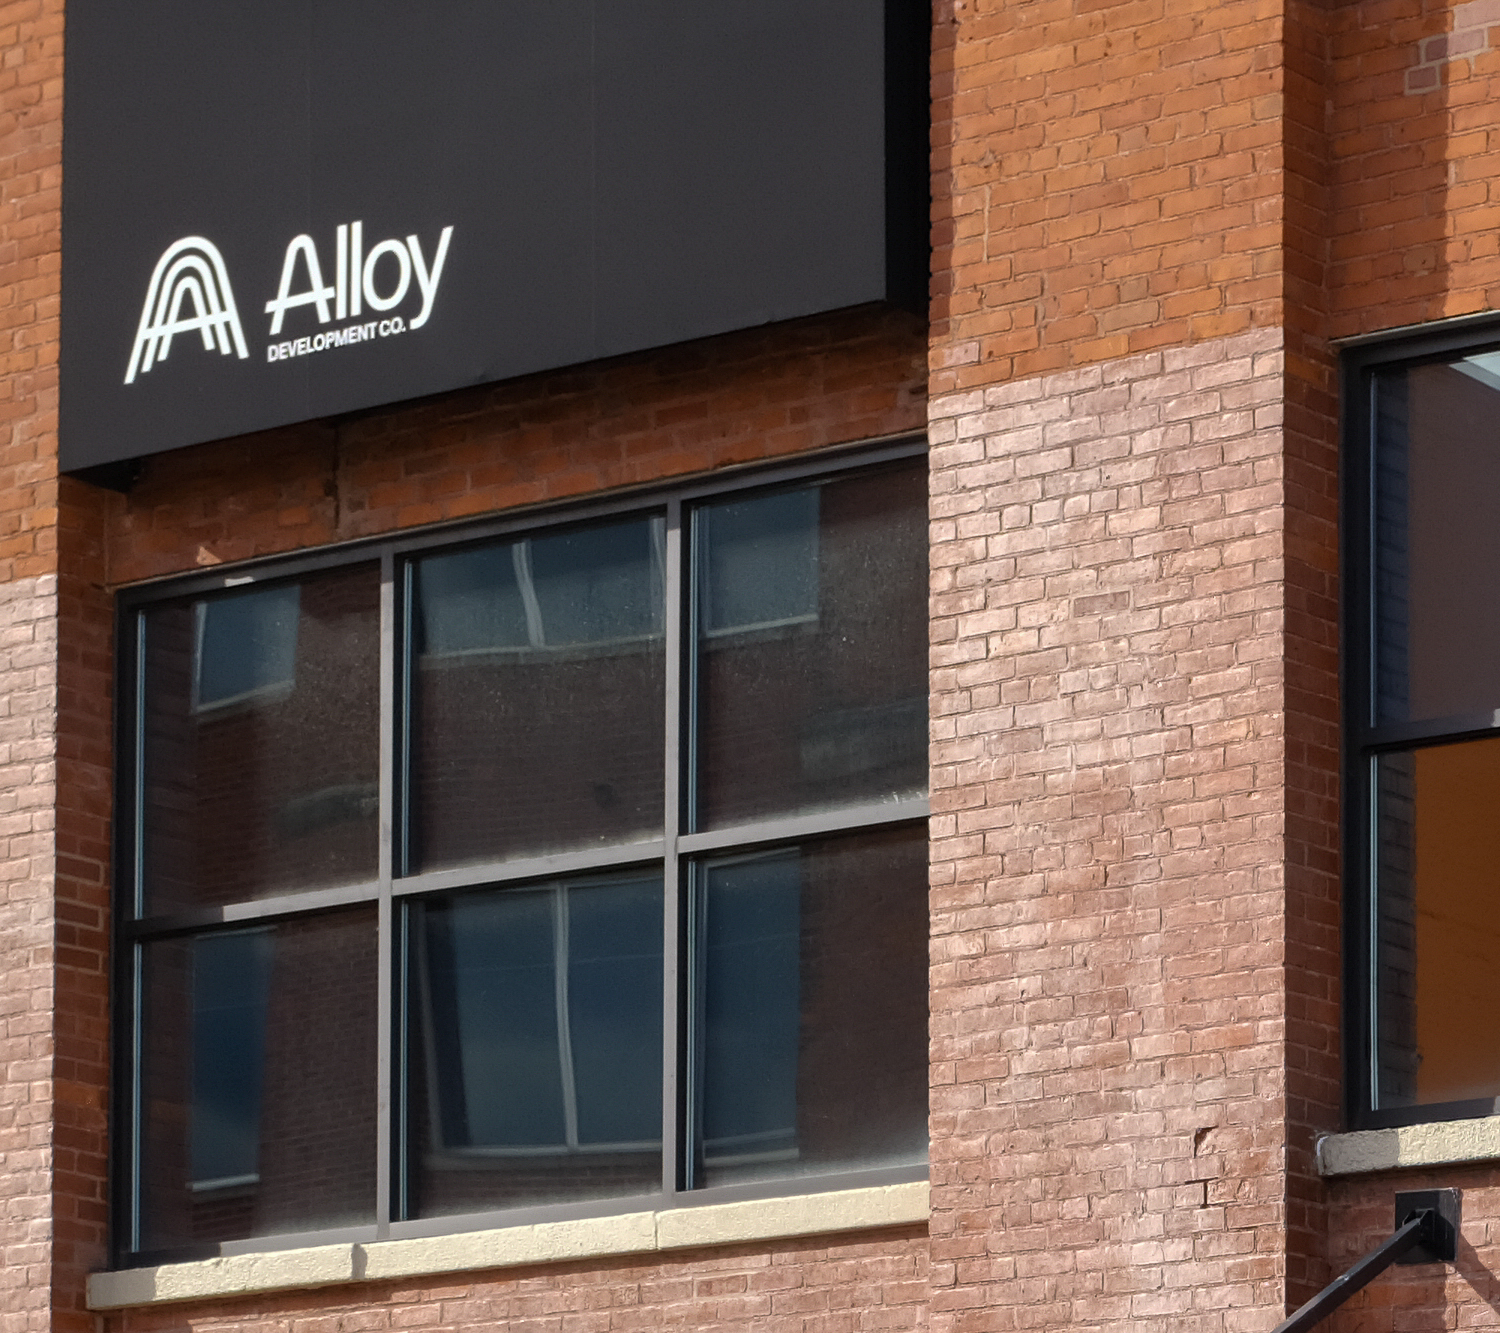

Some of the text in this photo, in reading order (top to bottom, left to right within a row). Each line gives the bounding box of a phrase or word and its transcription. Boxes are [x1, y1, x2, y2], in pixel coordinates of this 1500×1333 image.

[264, 219, 455, 336] Alloy
[266, 316, 407, 363] DEVELOPMENT CO.
